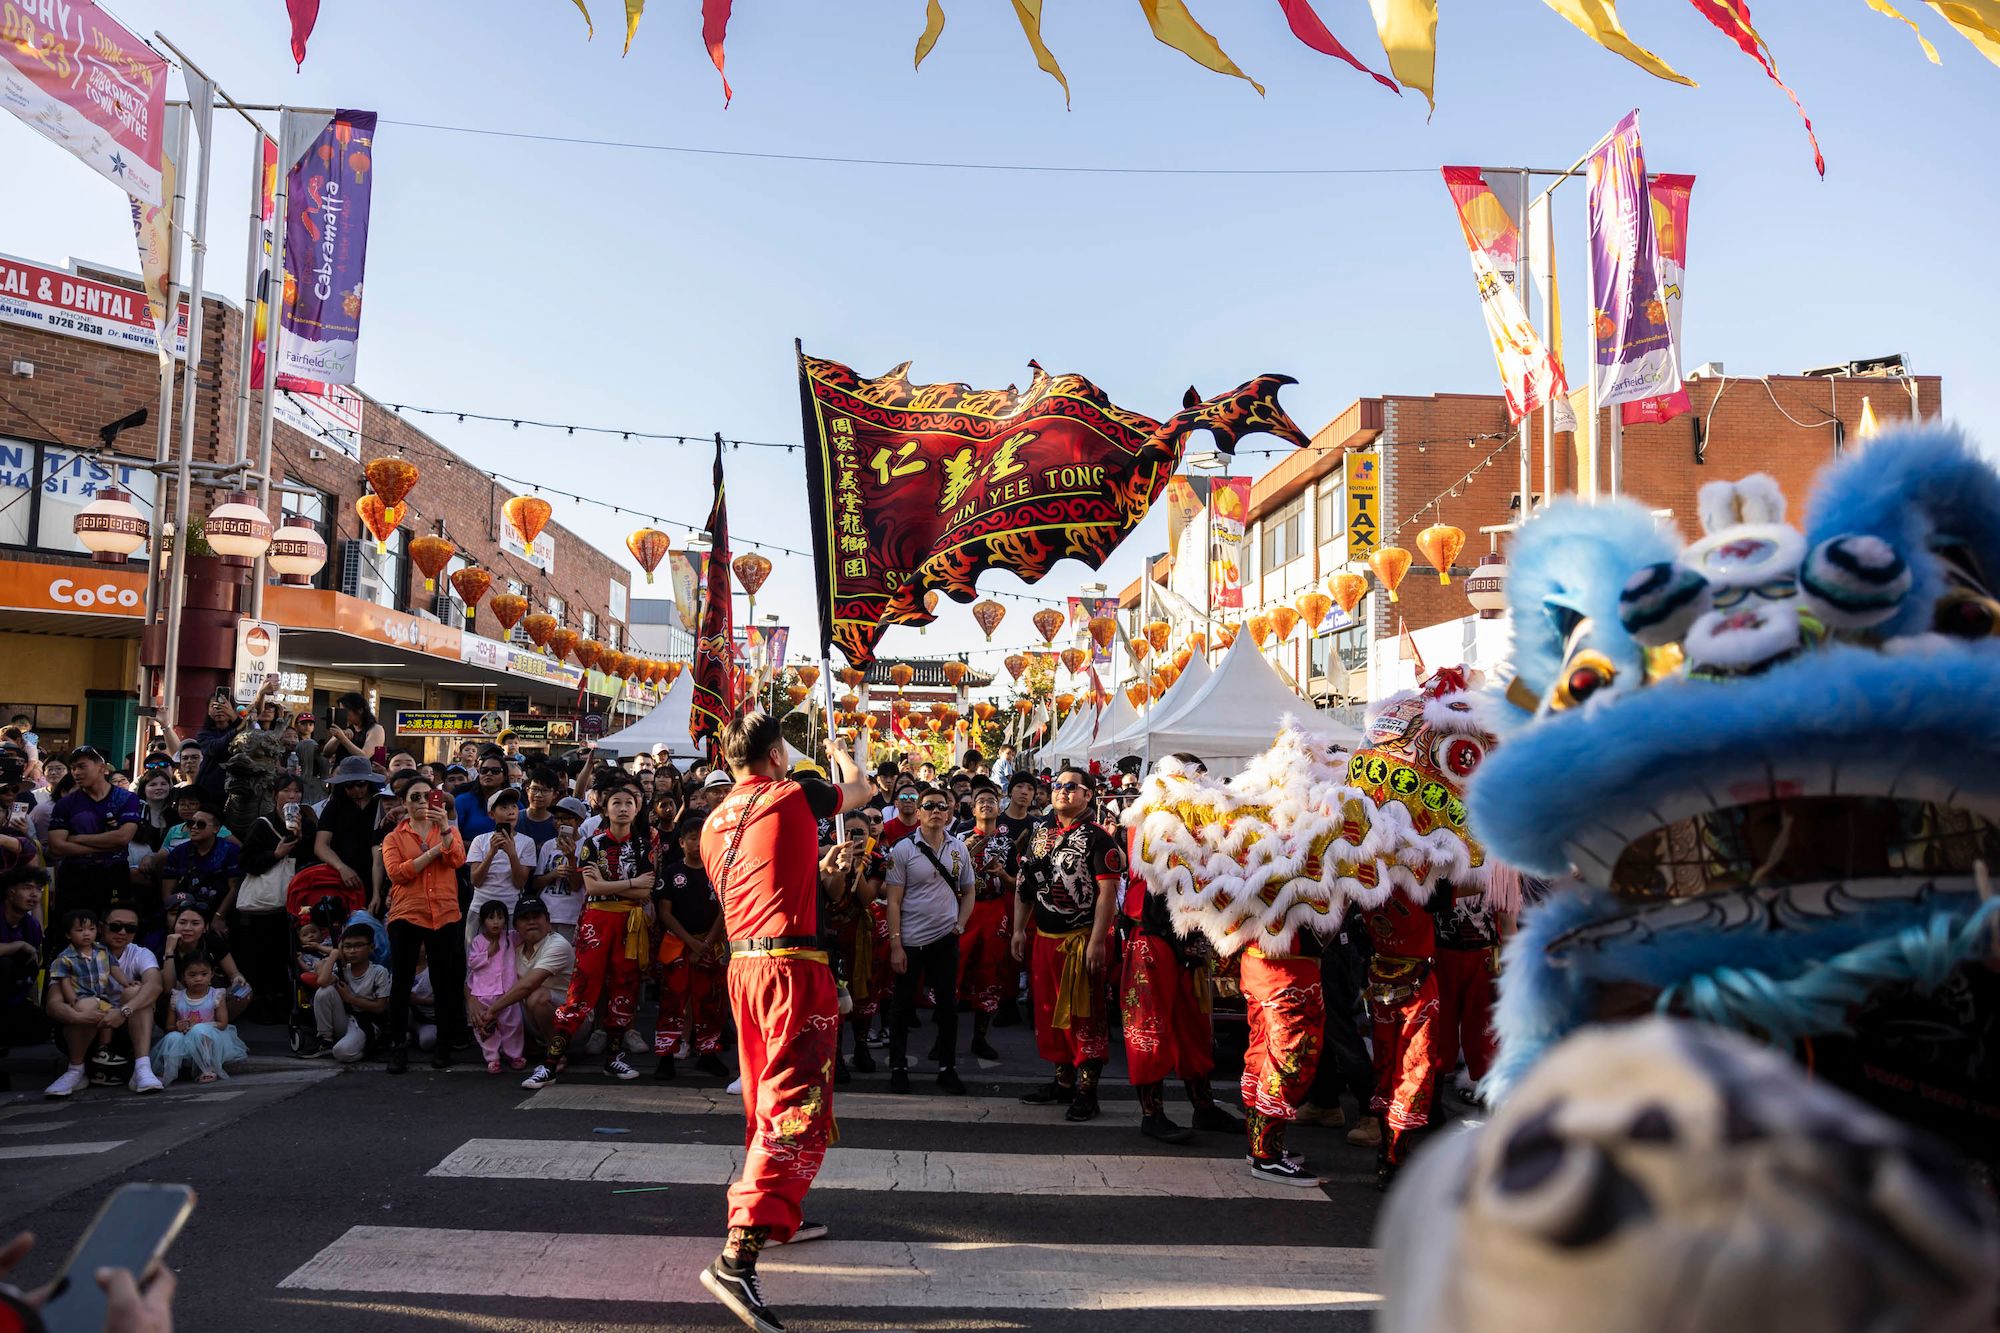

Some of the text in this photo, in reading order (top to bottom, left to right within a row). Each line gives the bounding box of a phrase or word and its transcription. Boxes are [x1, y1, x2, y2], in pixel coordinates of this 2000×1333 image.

[85, 83, 147, 141] TOWN CENTRE
[89, 66, 148, 124] CABRAMATTA
[313, 180, 344, 301] Cabramatta
[37, 277, 53, 302] &
[61, 281, 134, 320] DENTAL
[60, 310, 94, 324] PHONE
[49, 315, 74, 330] 9726
[77, 320, 103, 336] 2638
[989, 477, 1030, 505] YEE
[1045, 466, 1105, 489] TONG
[1351, 493, 1376, 546] TAX
[49, 578, 139, 607] CoCo
[239, 672, 265, 685] ENTR
[250, 660, 265, 671] NO
